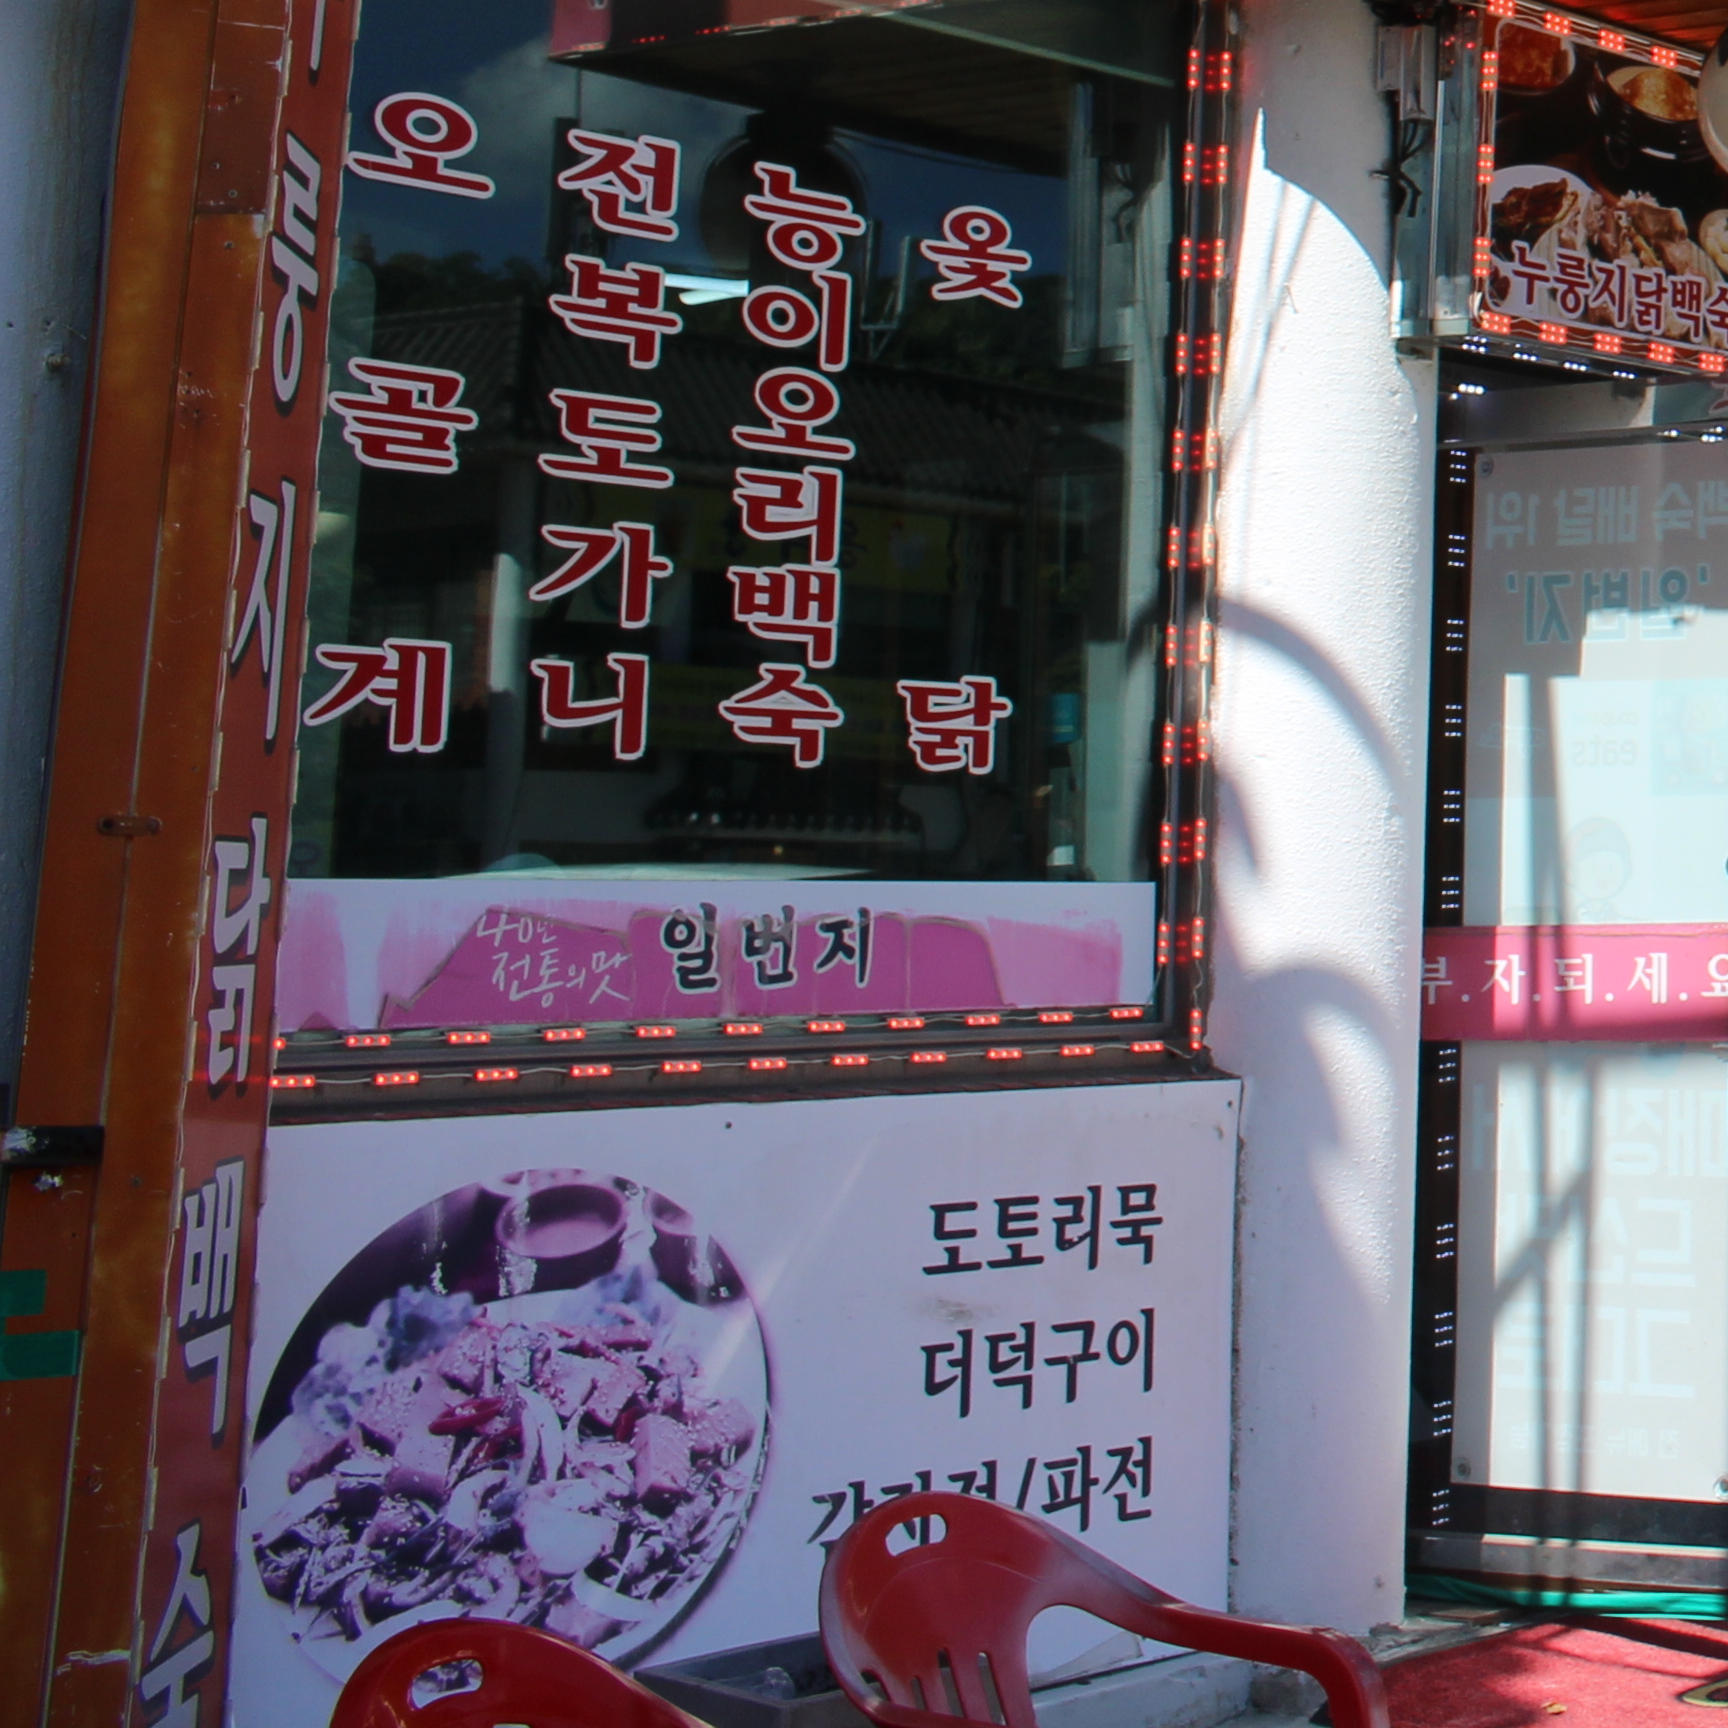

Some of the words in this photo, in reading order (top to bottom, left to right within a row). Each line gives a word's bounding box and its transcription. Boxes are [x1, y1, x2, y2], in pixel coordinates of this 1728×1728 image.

[528, 126, 684, 761] 전복도가니
[718, 160, 868, 770] 능이오리백숙
[658, 901, 878, 993] 일번지
[921, 1182, 1165, 1278] 도토리묵
[918, 1306, 1158, 1418] 더덕구이
